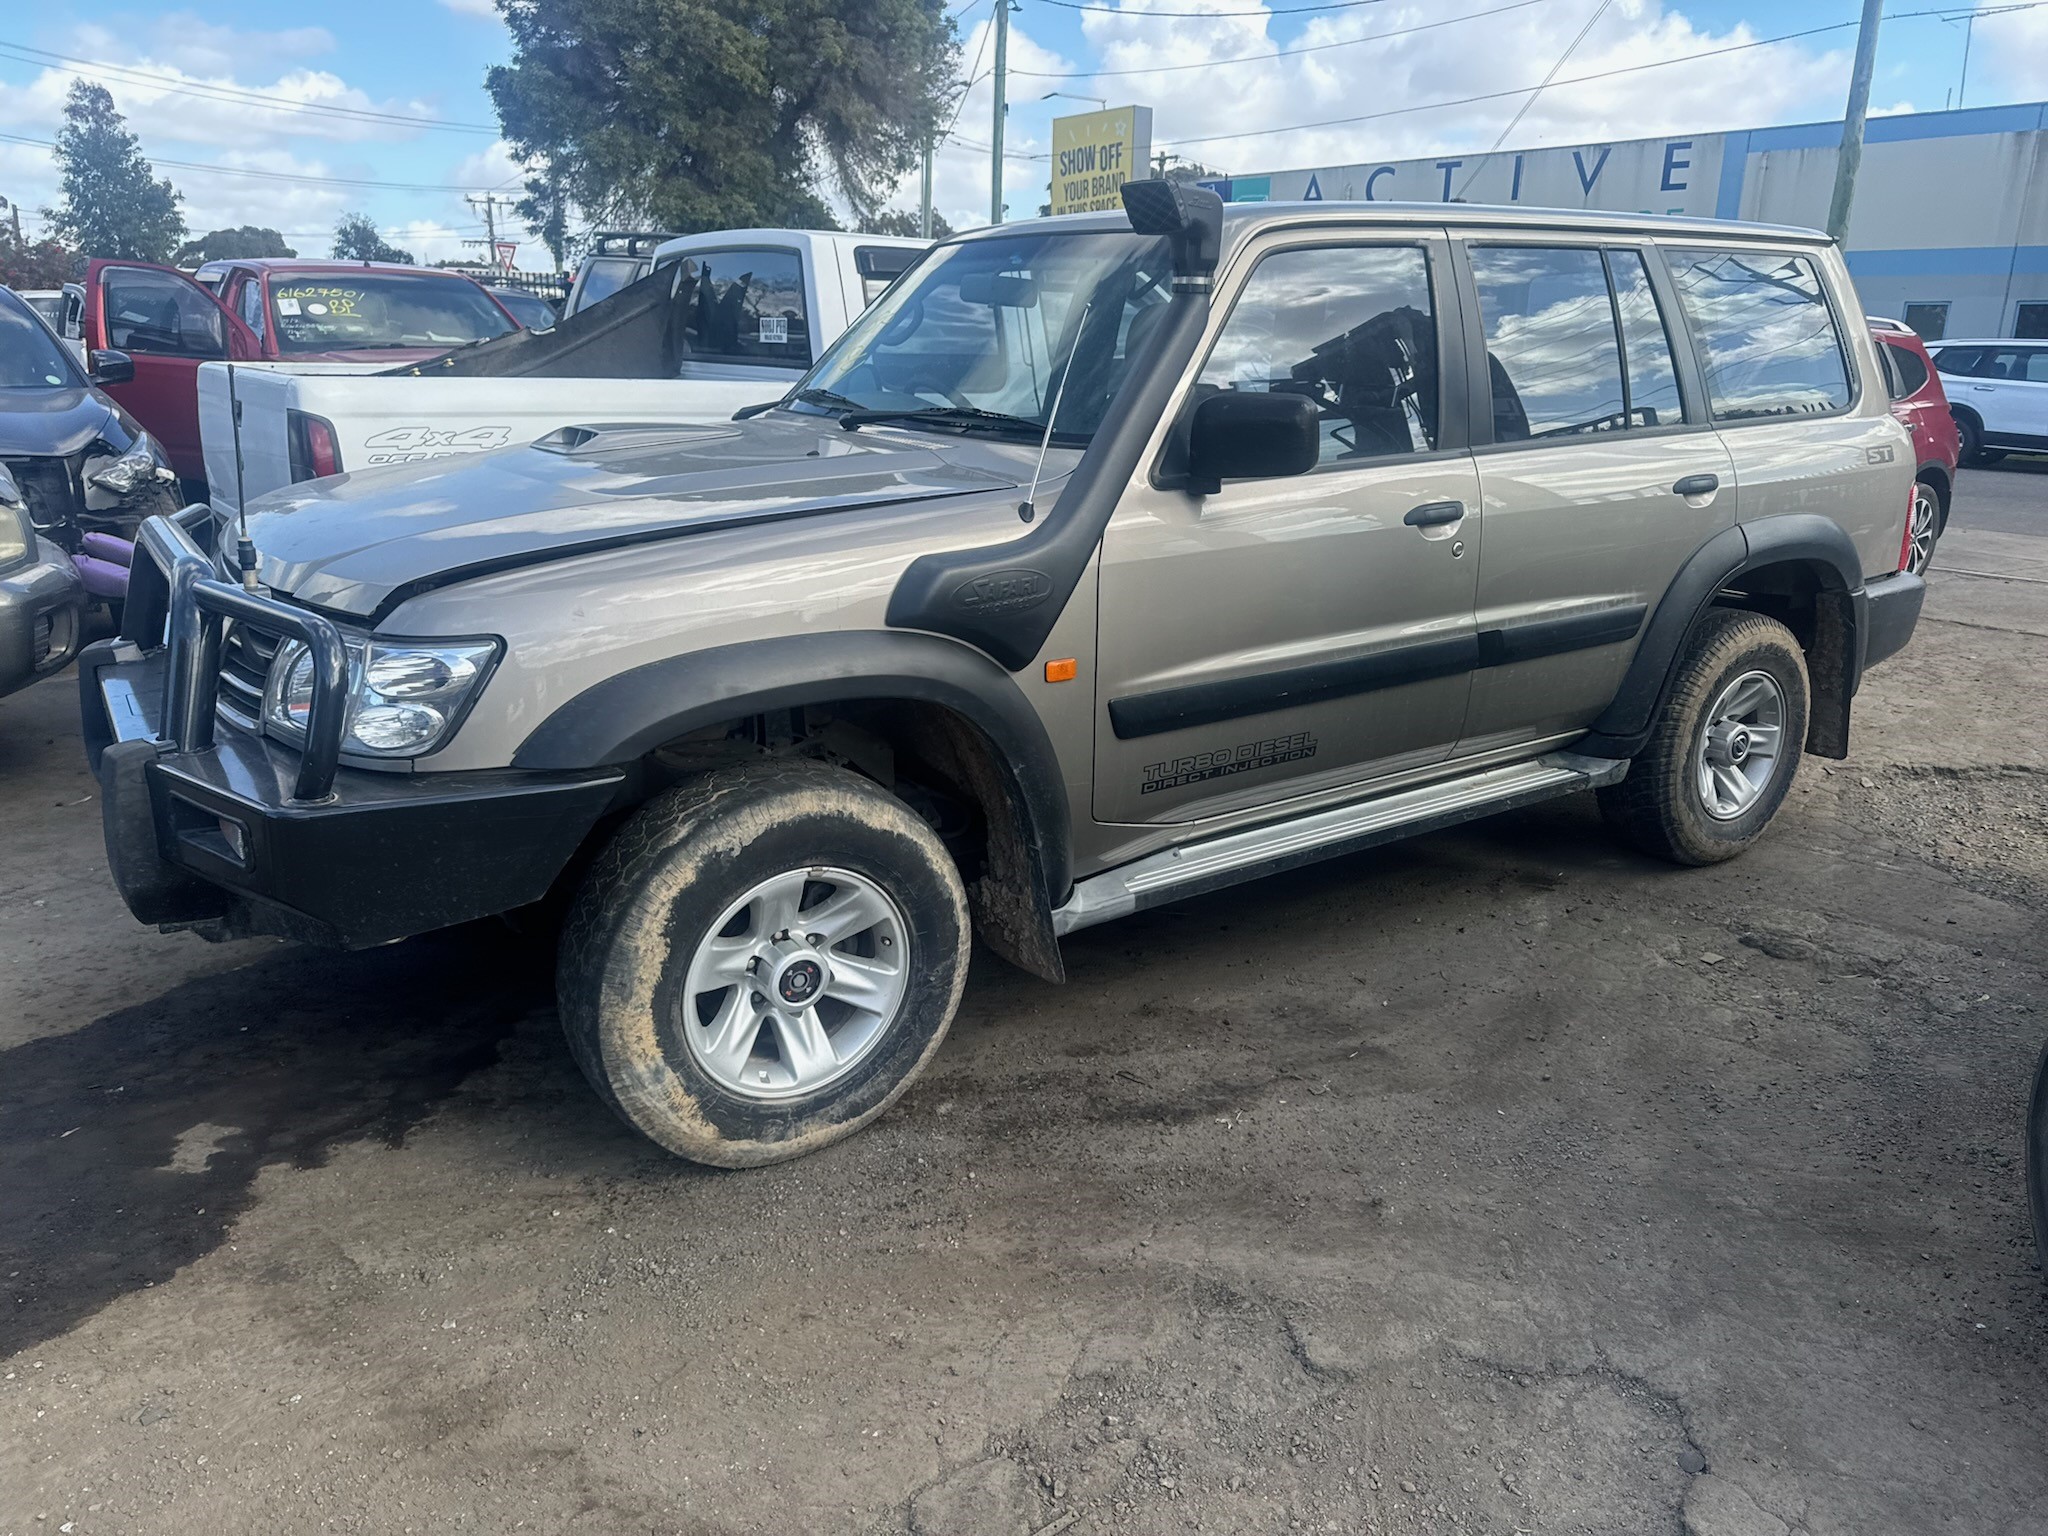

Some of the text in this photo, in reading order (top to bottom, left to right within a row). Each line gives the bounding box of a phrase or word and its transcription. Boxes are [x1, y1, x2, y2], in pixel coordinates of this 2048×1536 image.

[1060, 142, 1122, 177] SHOW OFF
[1303, 141, 1693, 202] ACTIVE
[1063, 171, 1126, 202] YOUR BRAND
[1090, 197, 1117, 212] SPACE
[365, 426, 512, 450] 4x4
[369, 453, 428, 464] OFF
[1868, 447, 1892, 463] ST
[965, 575, 1039, 602] SAFARI
[1142, 747, 1315, 793] DIRECT INJECTION
[1144, 732, 1318, 781] TURBO DIESEL
